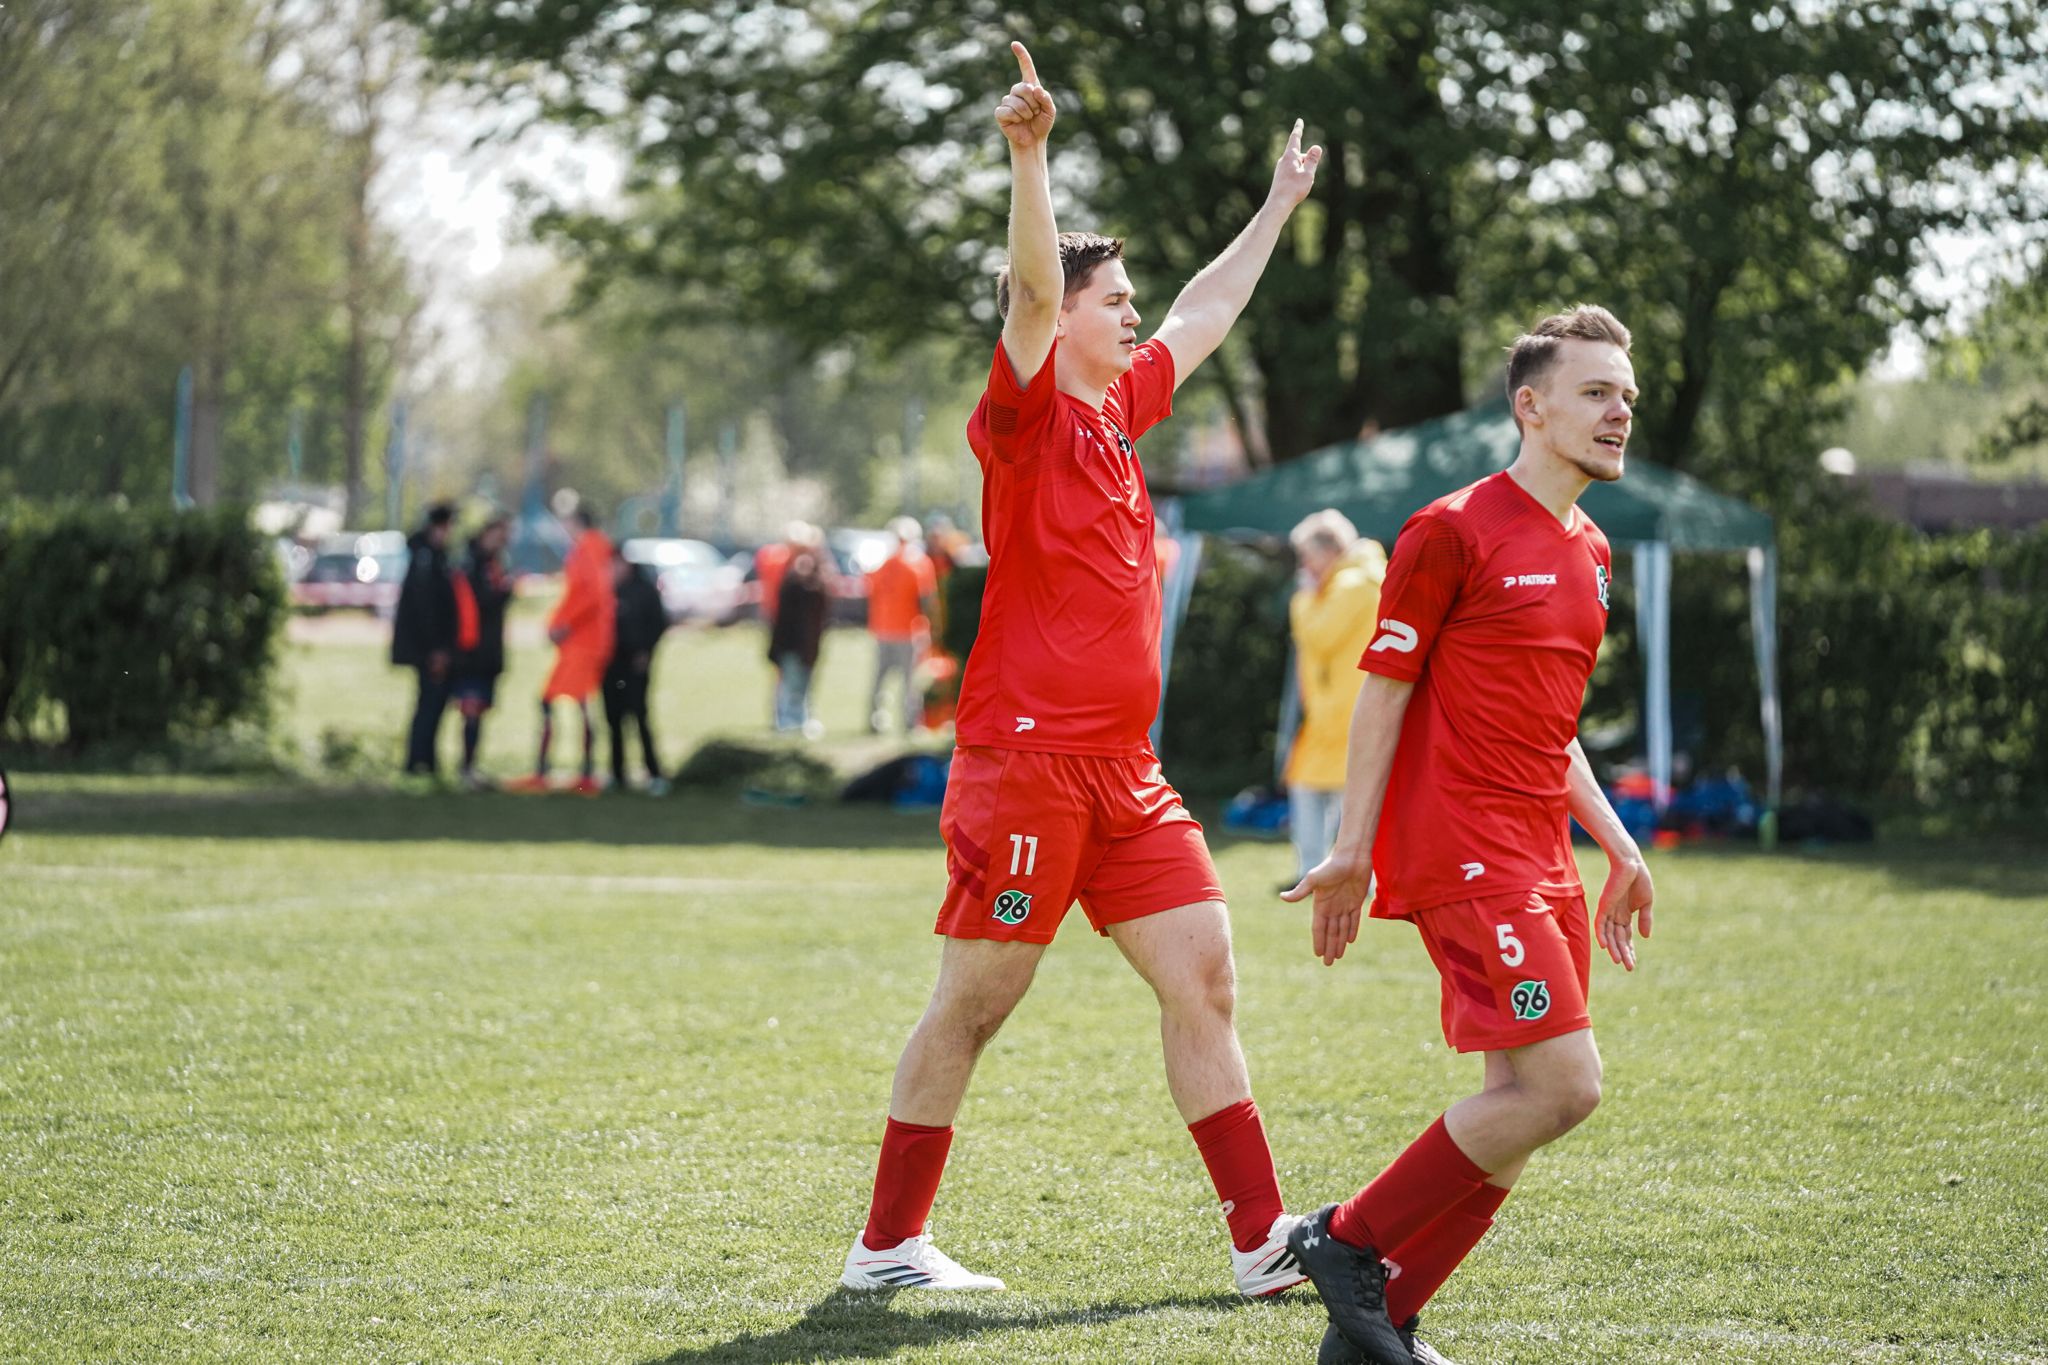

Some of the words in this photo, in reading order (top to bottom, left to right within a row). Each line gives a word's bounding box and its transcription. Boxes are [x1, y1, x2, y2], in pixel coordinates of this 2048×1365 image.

[1518, 574, 1557, 586] PATRICK
[1009, 834, 1038, 876] 11
[992, 891, 1032, 920] 96
[1496, 924, 1525, 967] 5
[1511, 981, 1550, 1018] 96
